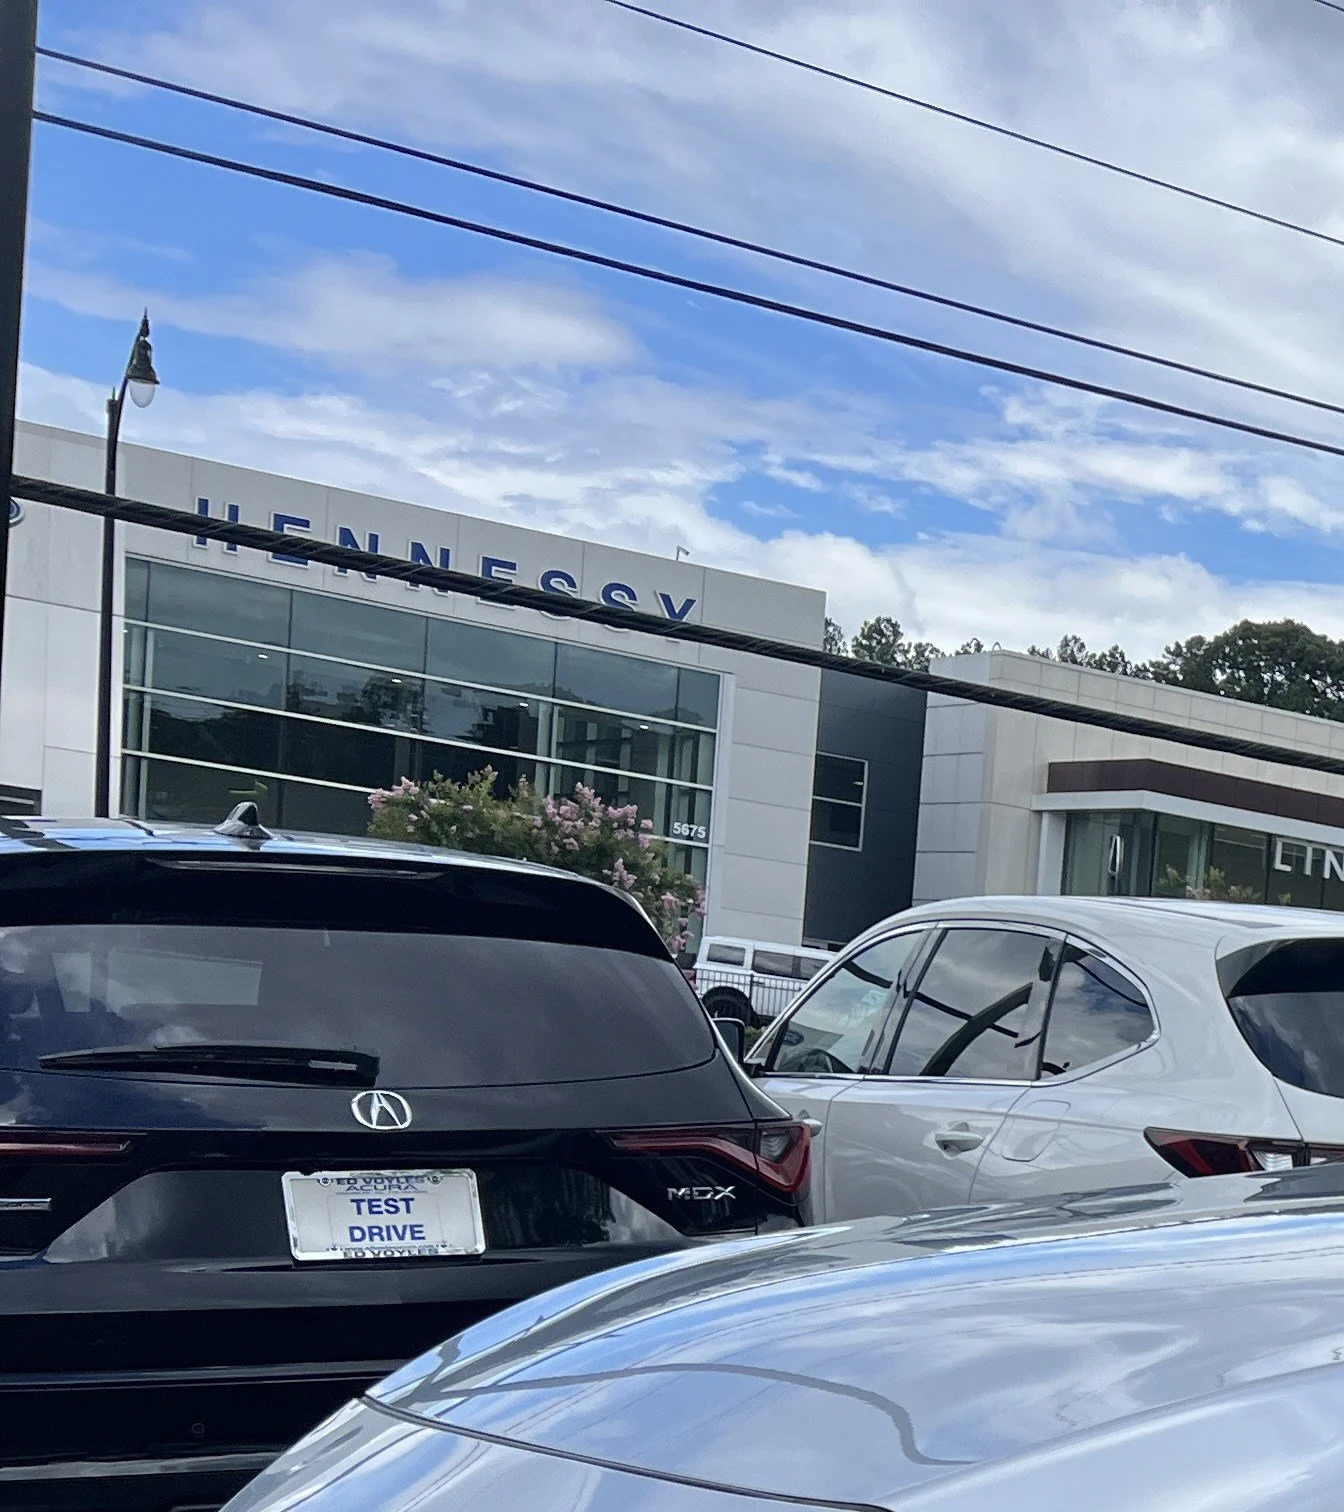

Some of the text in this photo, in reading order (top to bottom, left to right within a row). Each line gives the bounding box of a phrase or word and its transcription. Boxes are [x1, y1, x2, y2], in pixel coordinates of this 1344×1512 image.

[193, 497, 698, 641] HENNESSY
[672, 821, 707, 839] 5675
[336, 1175, 425, 1186] ED VOYLES
[345, 1184, 419, 1192] ACURA
[667, 1186, 736, 1201] MDX
[350, 1197, 415, 1216] TEST
[348, 1224, 426, 1243] DRIVE
